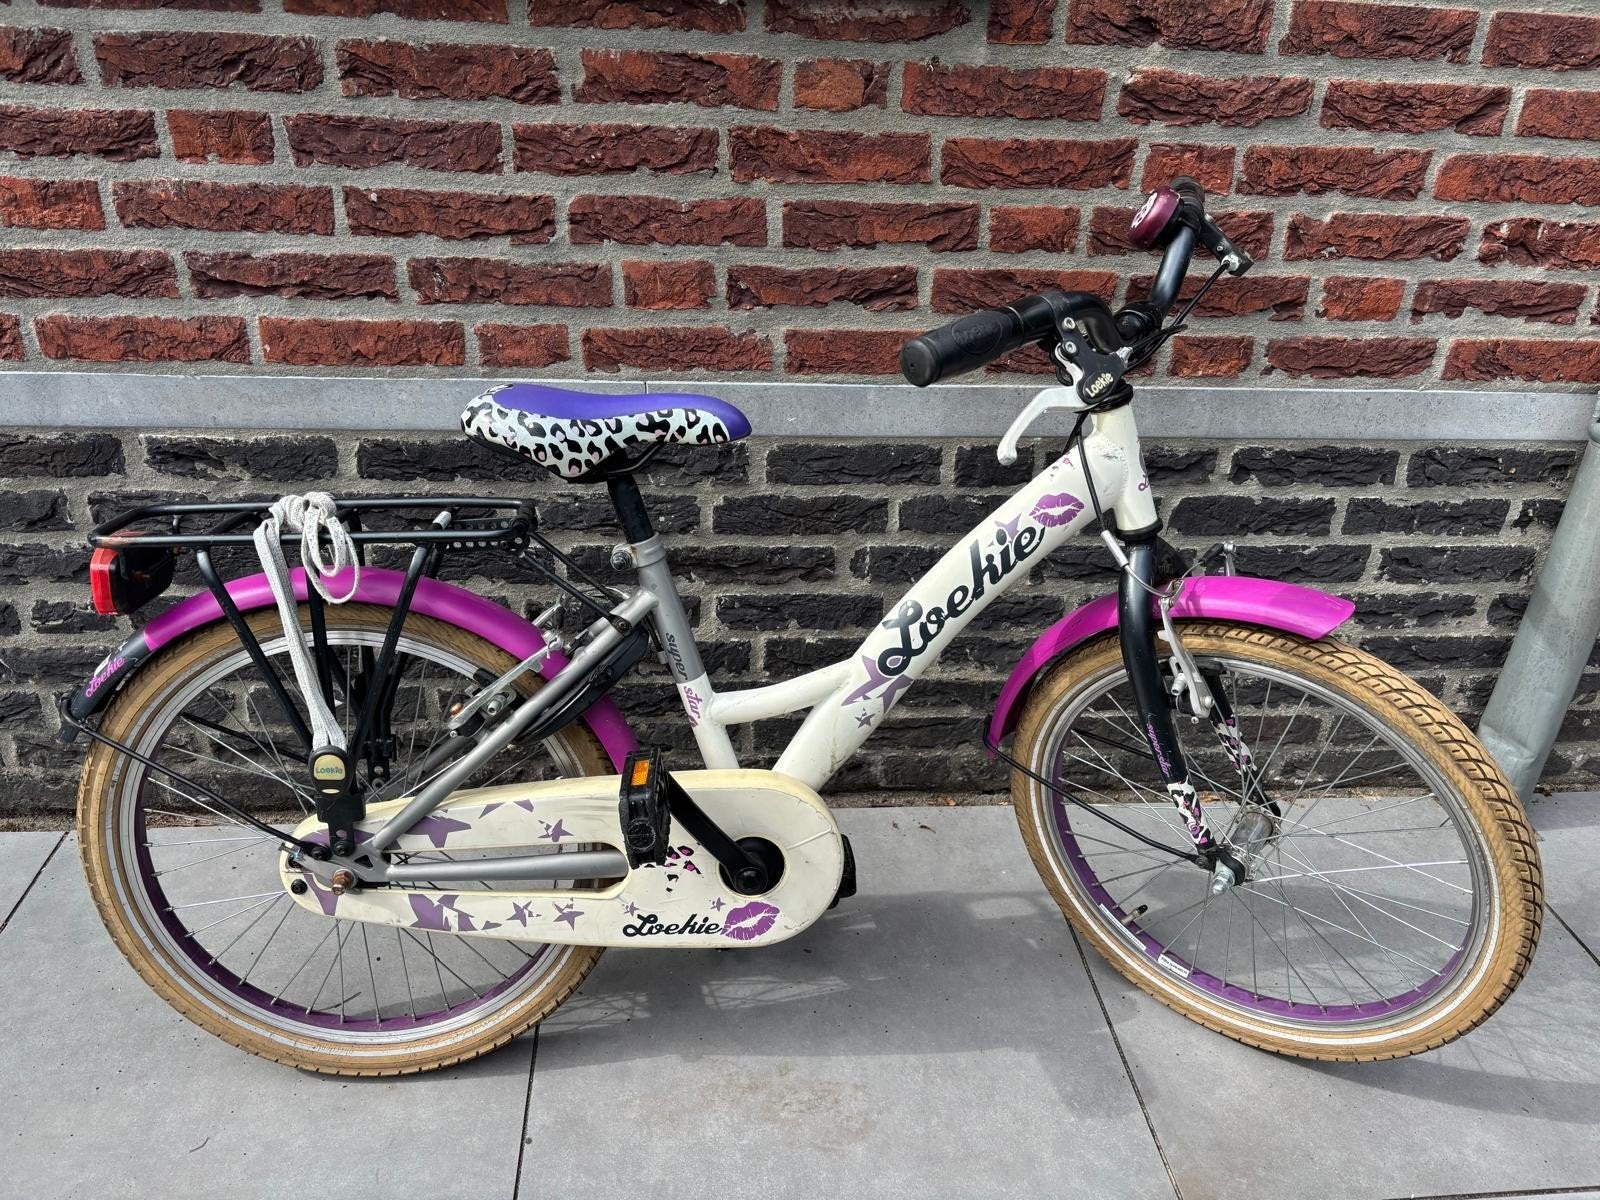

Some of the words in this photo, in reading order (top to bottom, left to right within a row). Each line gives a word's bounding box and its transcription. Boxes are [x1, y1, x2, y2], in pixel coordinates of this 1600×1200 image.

[1085, 373, 1114, 397] Loekie
[877, 526, 1046, 676] Loekie
[86, 657, 125, 697] Loekie
[666, 632, 688, 680] super
[684, 686, 702, 719] star
[622, 913, 723, 937] Loekie
